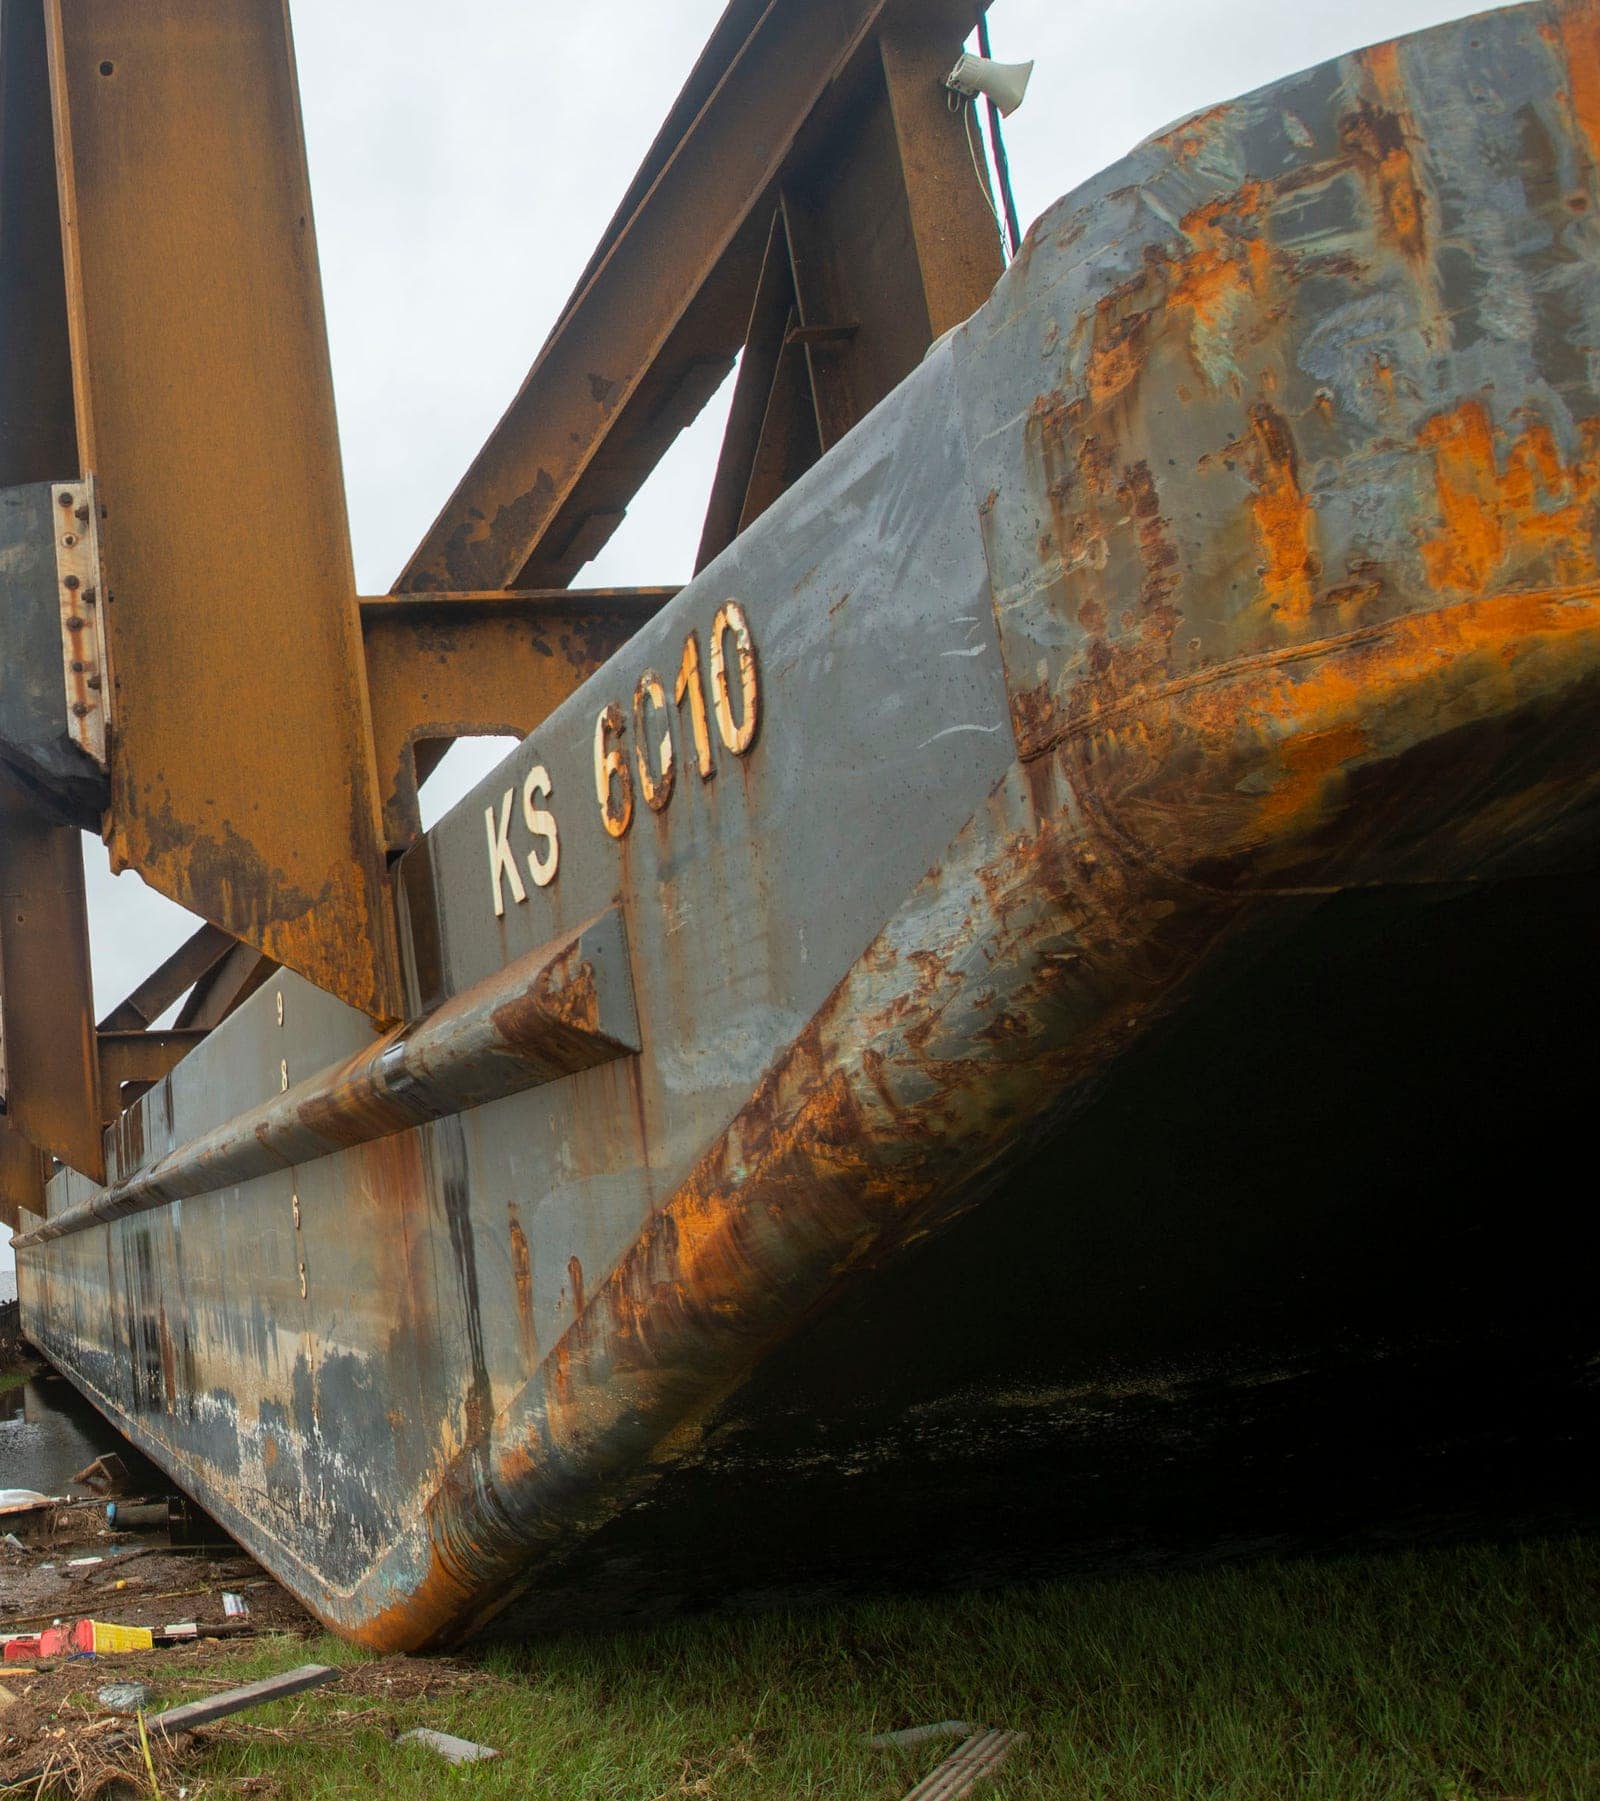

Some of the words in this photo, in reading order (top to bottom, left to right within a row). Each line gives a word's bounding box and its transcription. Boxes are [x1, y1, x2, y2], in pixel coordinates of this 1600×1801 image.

[485, 765, 559, 917] KS
[593, 599, 760, 840] 6010
[276, 991, 284, 1027] 9
[280, 1058, 289, 1091] 8
[292, 1194, 300, 1230] 6
[299, 1262, 307, 1299] 5
